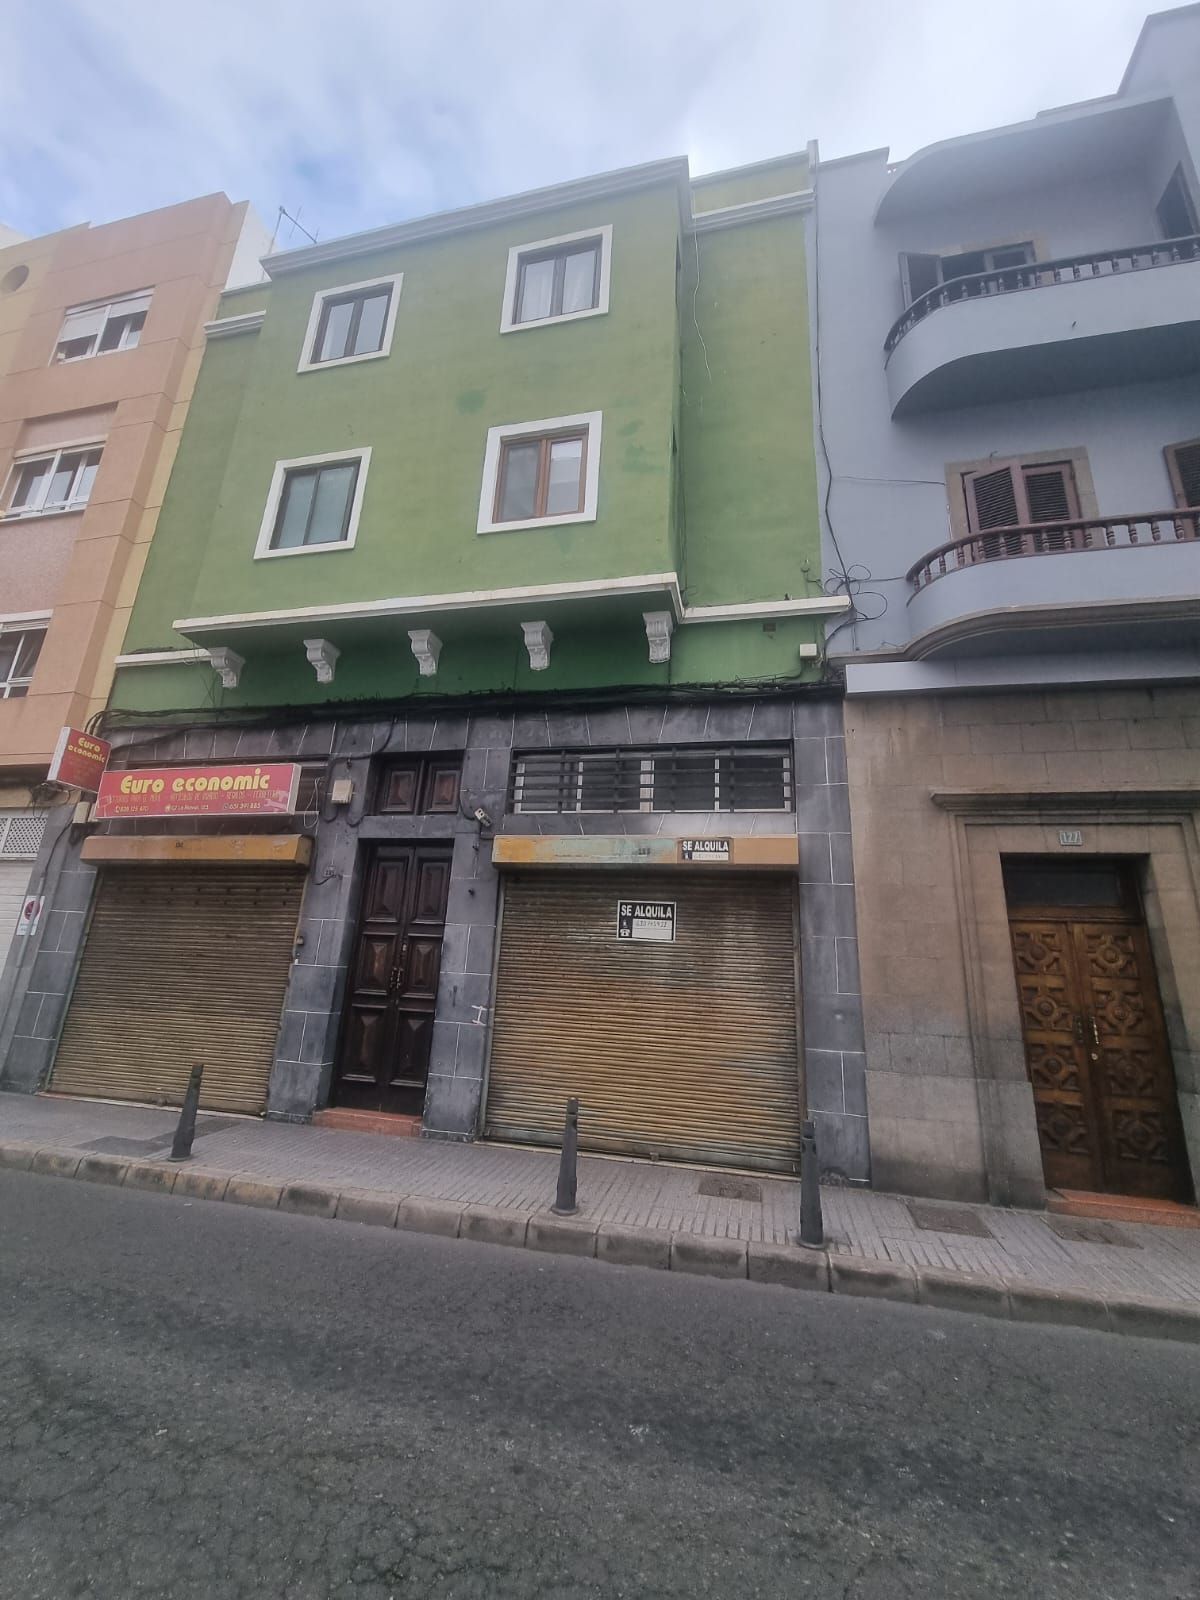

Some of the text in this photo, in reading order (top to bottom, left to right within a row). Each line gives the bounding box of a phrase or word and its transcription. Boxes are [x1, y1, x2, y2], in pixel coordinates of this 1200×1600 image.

[78, 737, 101, 752] Euro
[68, 744, 105, 763] economic
[120, 767, 270, 794] Euro economic
[682, 840, 729, 851] SE ALQUILA
[621, 905, 673, 918] SE ALQUILA
